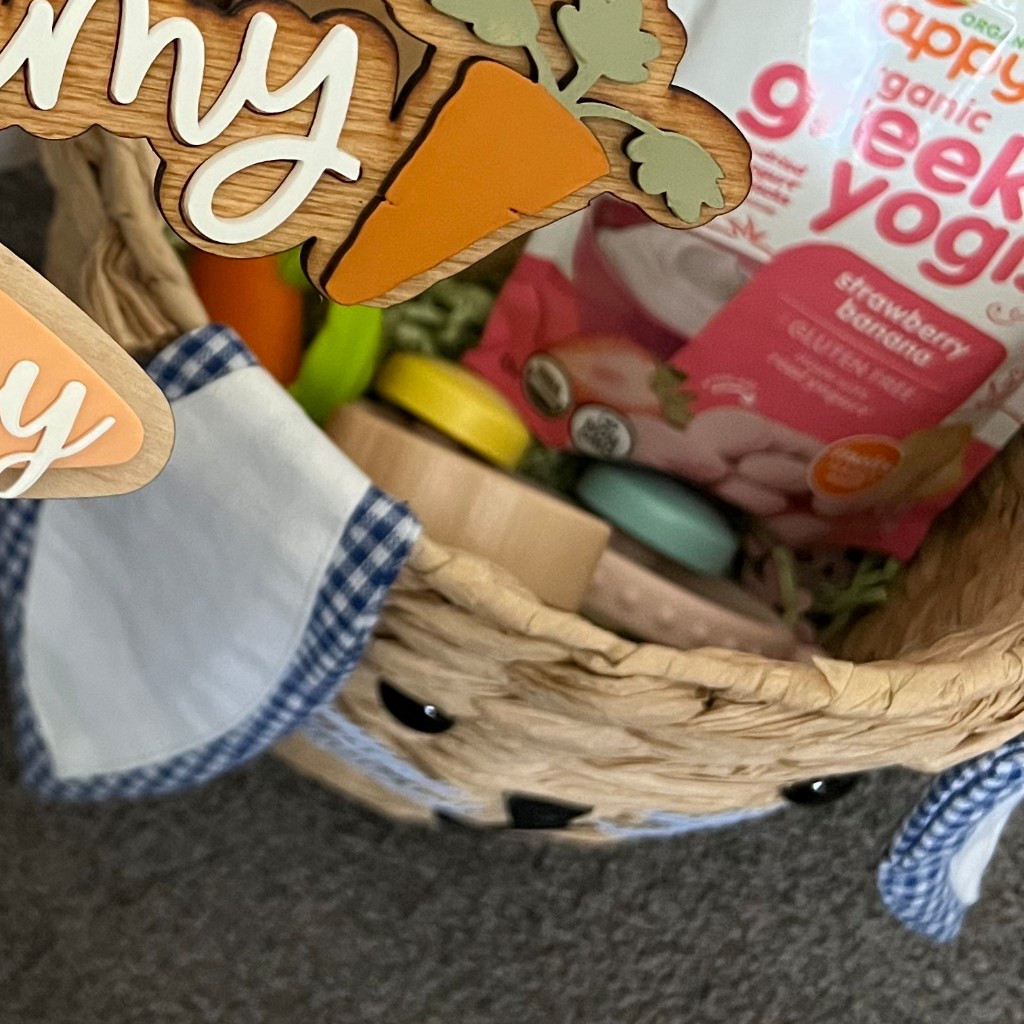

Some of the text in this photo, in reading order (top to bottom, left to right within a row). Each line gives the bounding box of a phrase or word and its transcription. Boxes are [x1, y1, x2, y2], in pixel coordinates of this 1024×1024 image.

[736, 61, 1024, 223] geek
[833, 271, 972, 362] strawberry
[836, 297, 933, 368] banana
